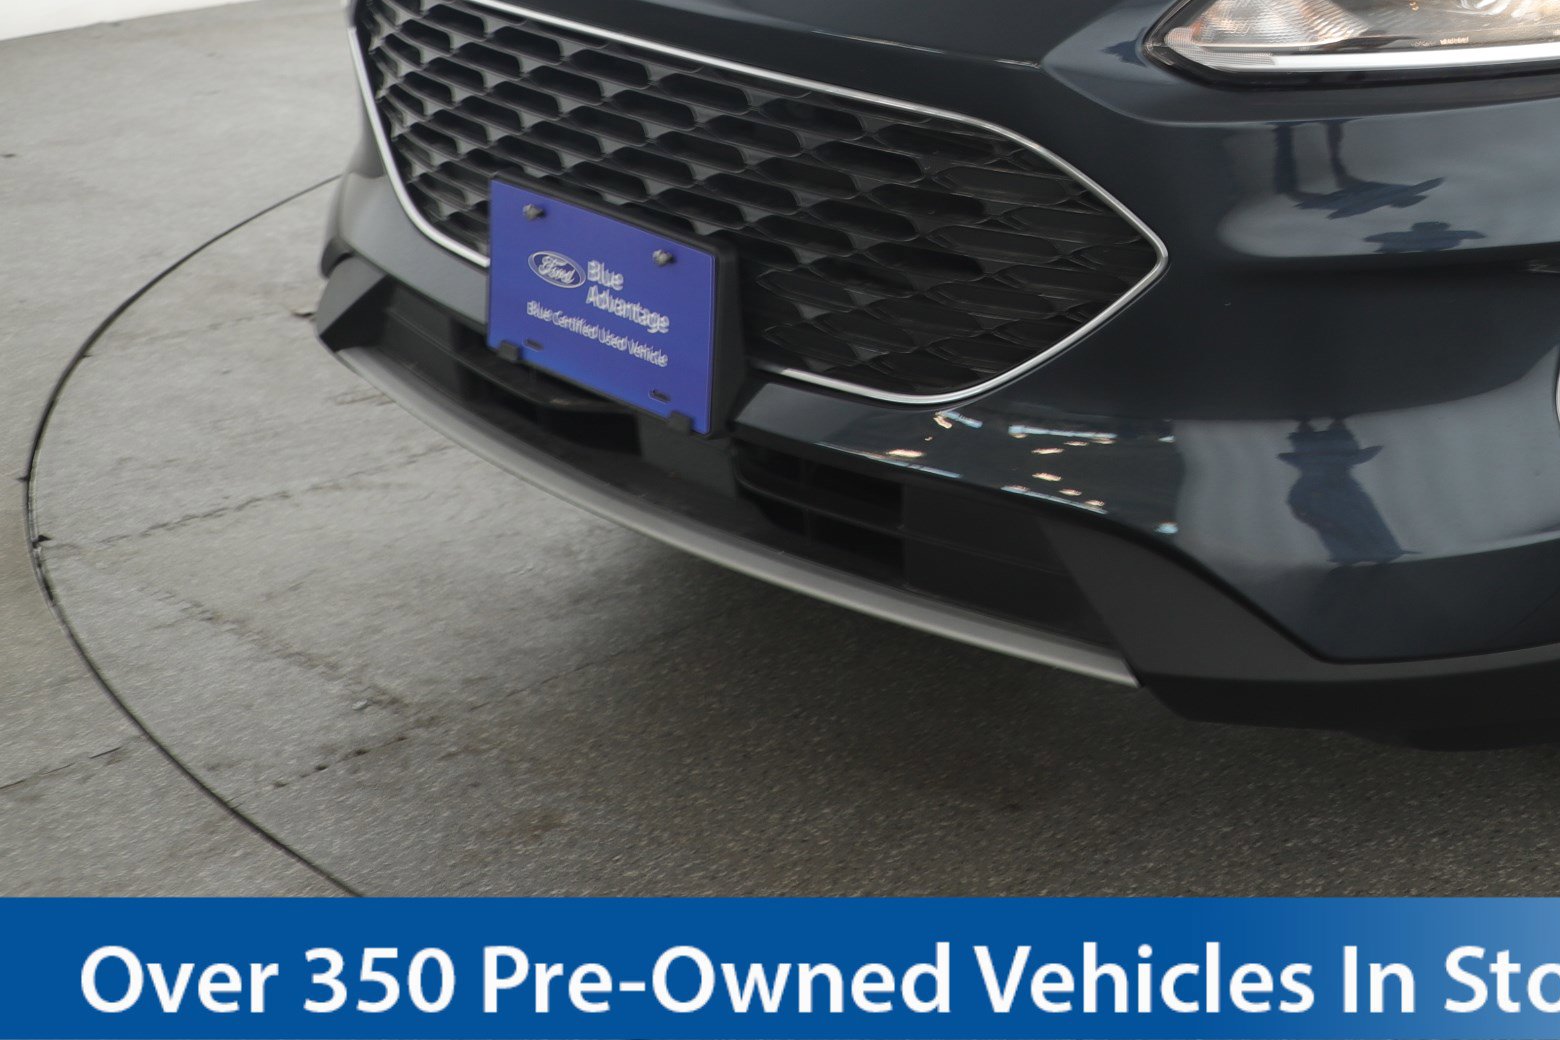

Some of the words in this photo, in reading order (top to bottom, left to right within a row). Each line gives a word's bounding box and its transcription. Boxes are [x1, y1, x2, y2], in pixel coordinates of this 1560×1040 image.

[538, 255, 576, 284] Ford
[587, 260, 624, 291] Blue
[585, 285, 670, 334] Advantage
[526, 300, 553, 322] Blue
[552, 310, 599, 339] Certified
[598, 326, 628, 351] Used
[627, 339, 668, 367] Vehicle
